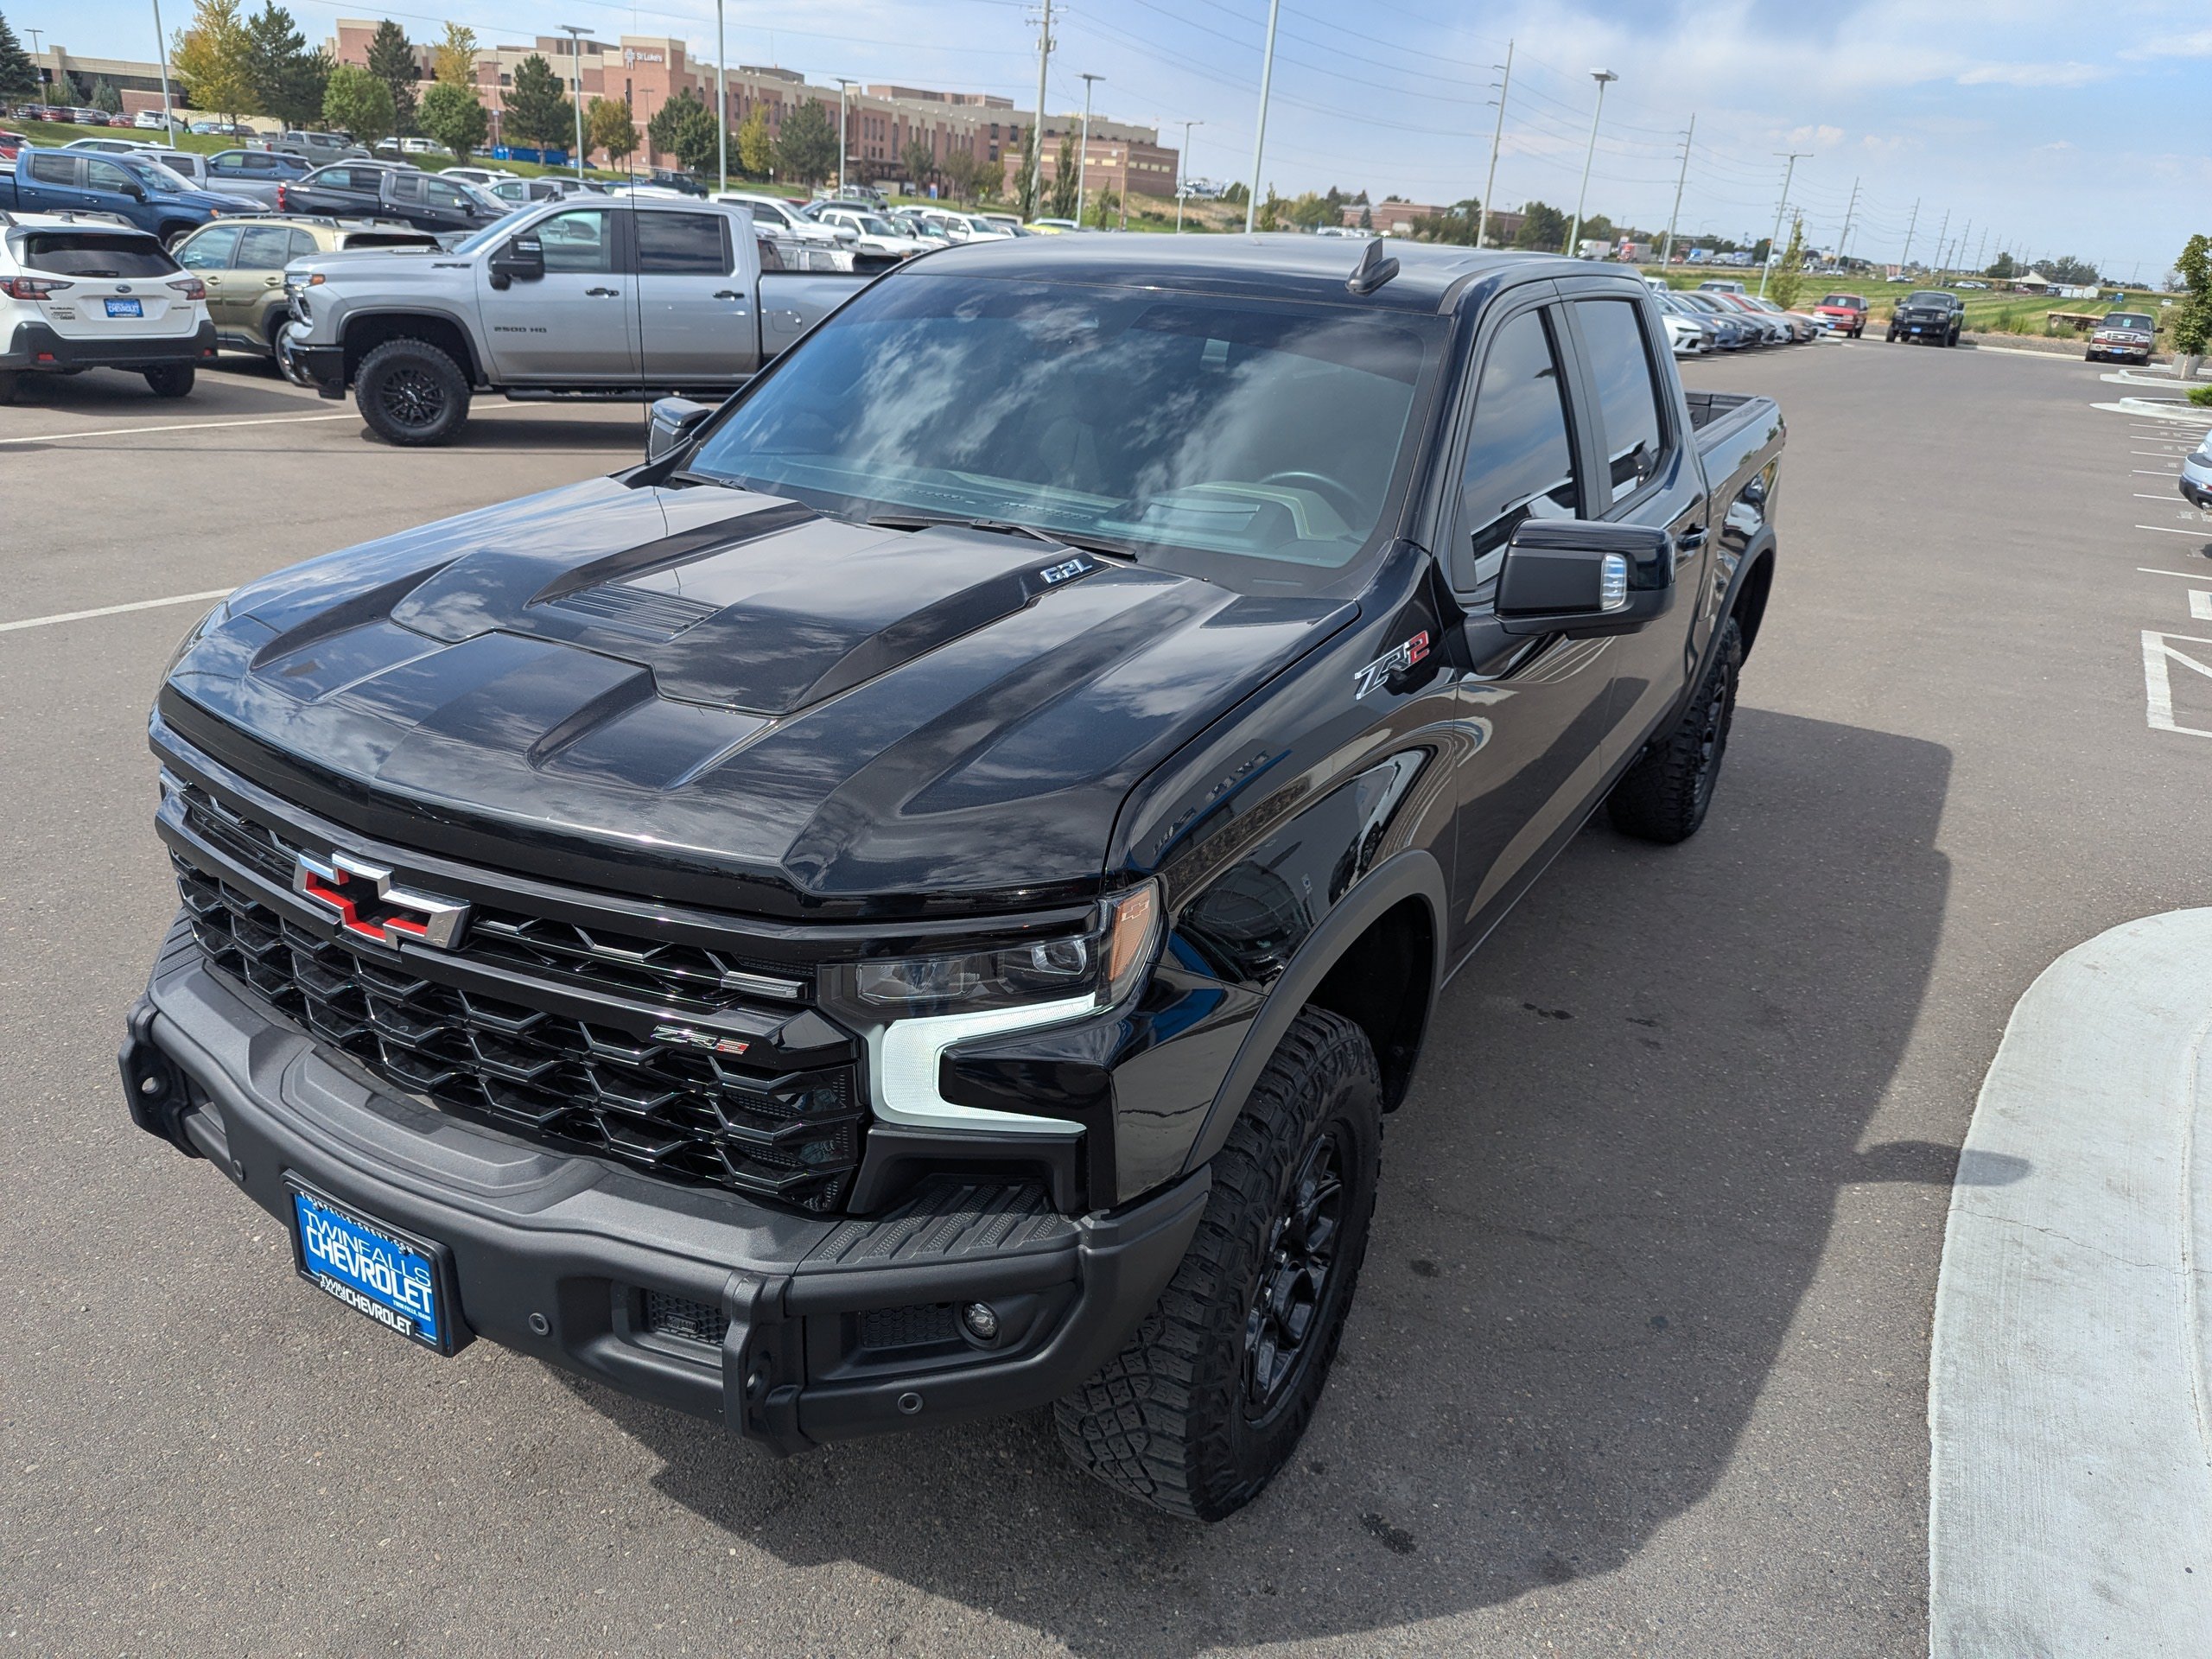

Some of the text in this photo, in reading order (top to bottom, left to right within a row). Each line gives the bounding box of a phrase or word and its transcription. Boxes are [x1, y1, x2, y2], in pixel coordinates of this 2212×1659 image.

[1354, 630, 1430, 700] ZR2
[650, 1024, 751, 1055] ZR2
[306, 1224, 432, 1314] CHEVROLET
[319, 1274, 346, 1295] TWIN
[346, 1287, 412, 1336] CHEVROLET
